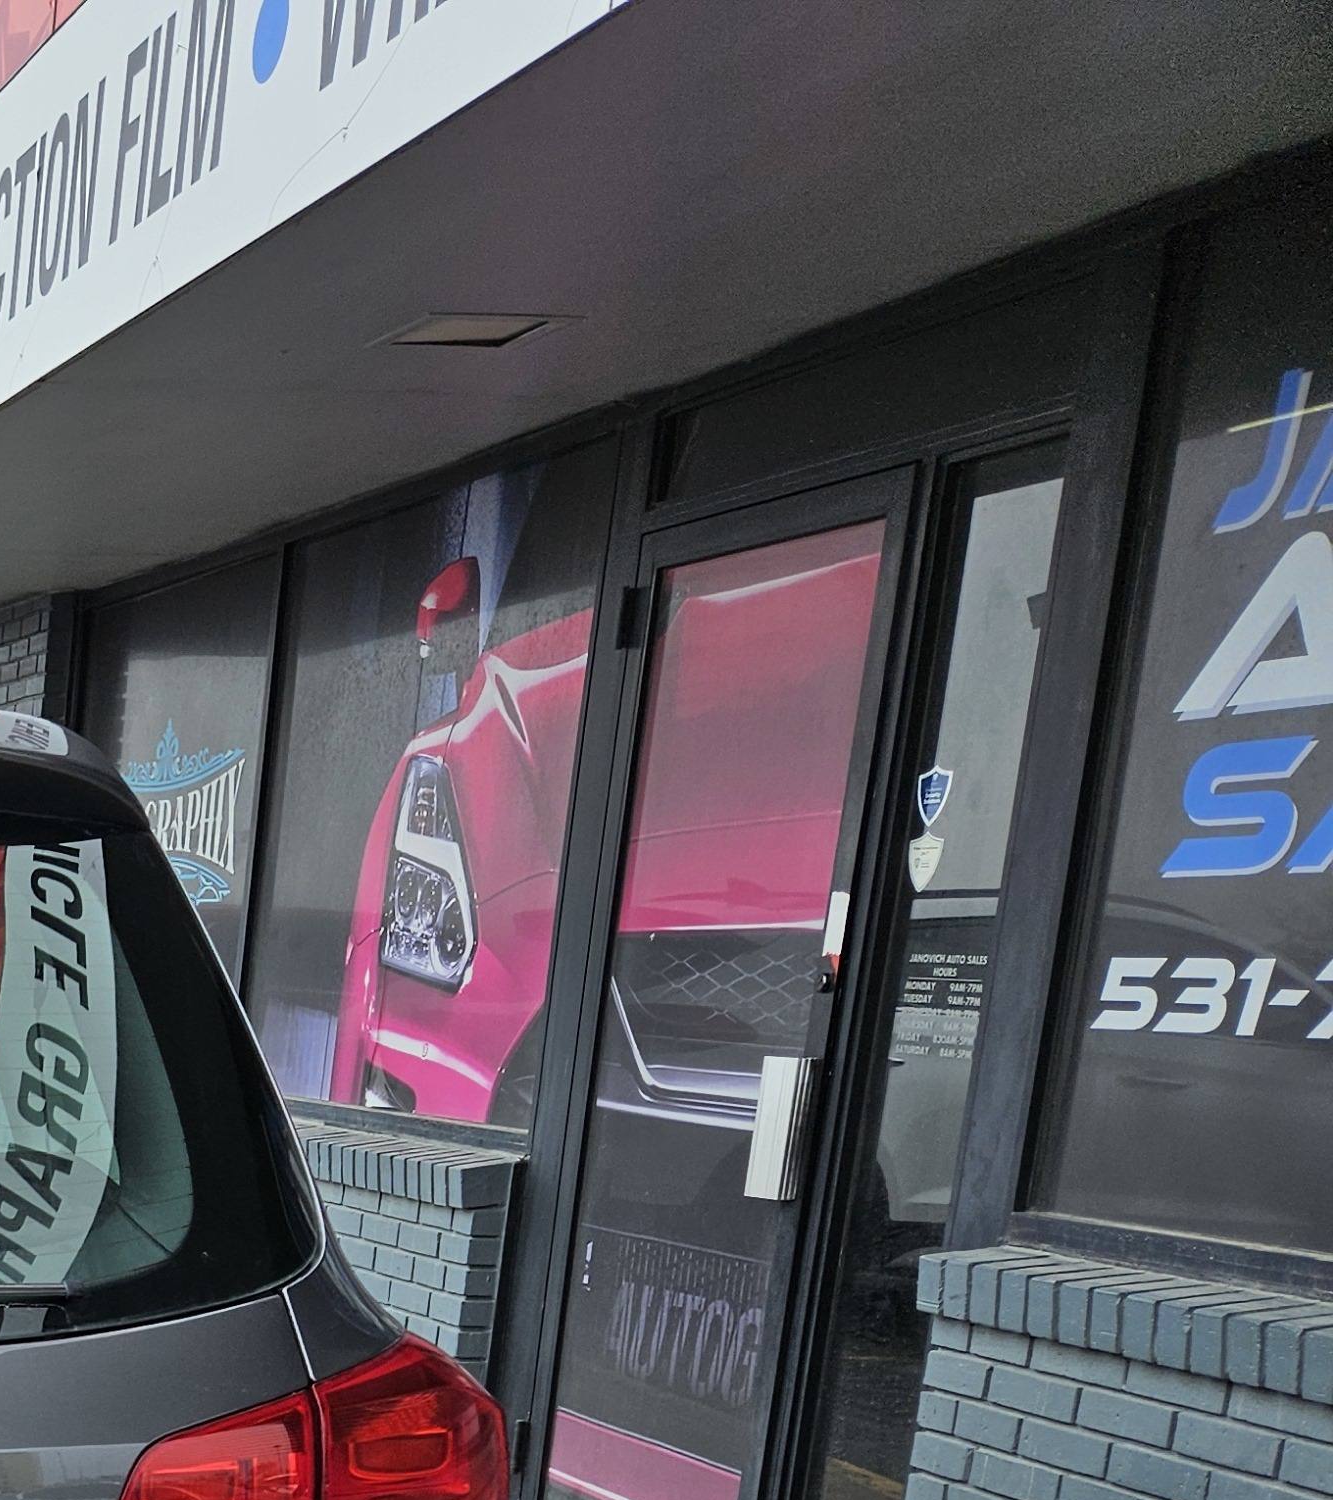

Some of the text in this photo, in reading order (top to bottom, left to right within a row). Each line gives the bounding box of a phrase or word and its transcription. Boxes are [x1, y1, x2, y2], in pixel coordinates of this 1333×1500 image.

[109, 0, 235, 247] FILM
[909, 953, 988, 965] JANOVICH AUTO SALES
[933, 967, 957, 977] HOURS
[904, 981, 983, 993] MONDAY 9AM-7PM
[903, 993, 981, 1007] TUESDAY 9AM-7PM
